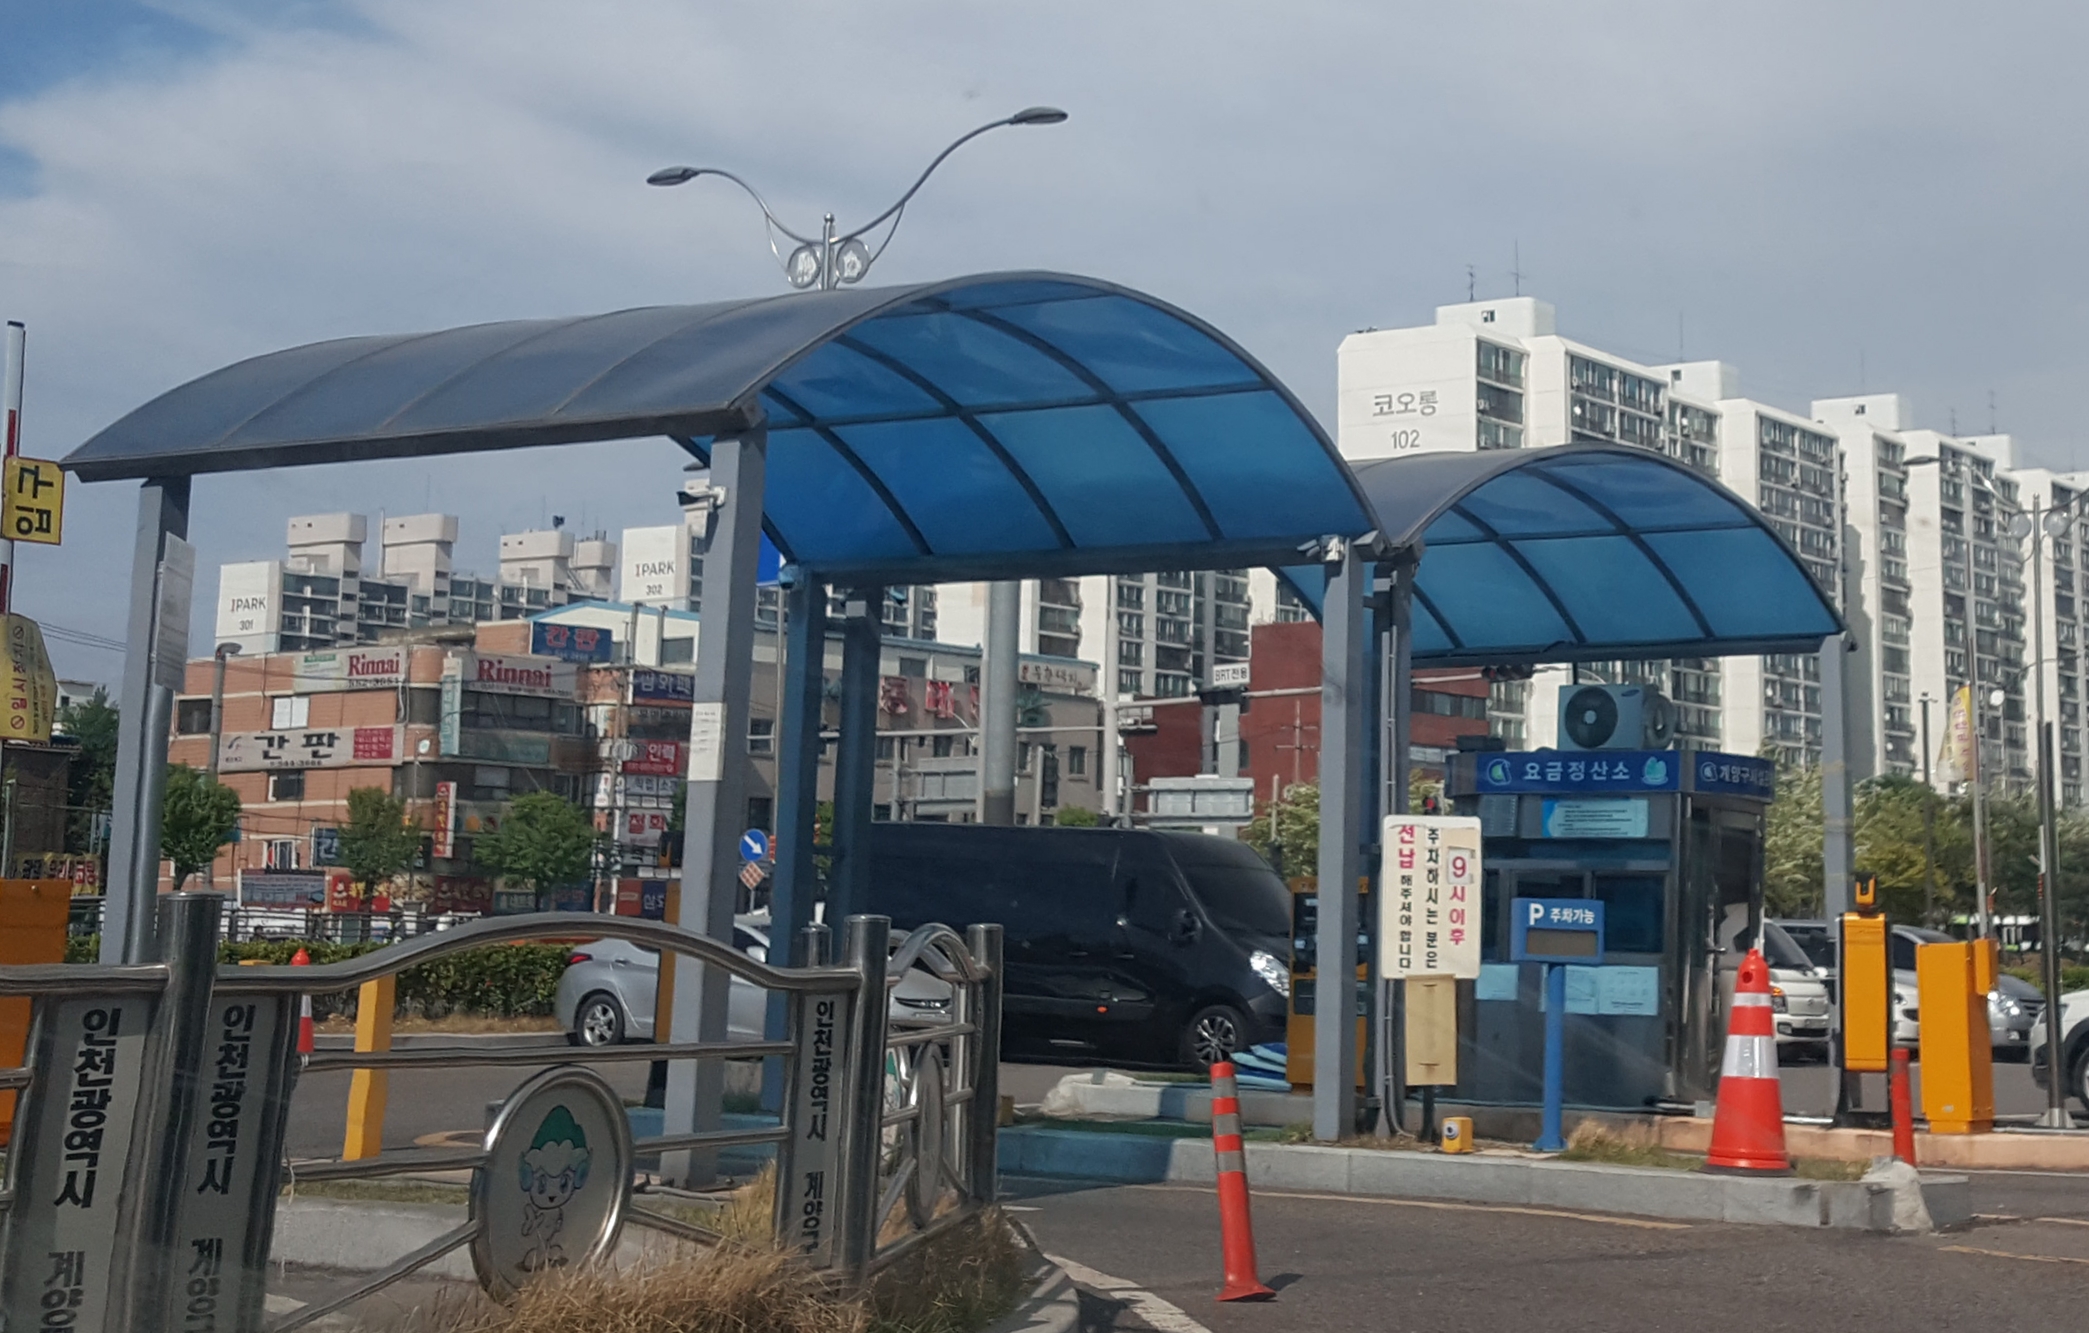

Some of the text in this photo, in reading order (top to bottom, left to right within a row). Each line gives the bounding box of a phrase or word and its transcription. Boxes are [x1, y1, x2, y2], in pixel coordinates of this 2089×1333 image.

[1373, 390, 1438, 417] 코오롱
[1391, 429, 1421, 449] 102
[646, 584, 663, 595] 302
[239, 619, 254, 631] 301
[347, 652, 400, 677] Rinnai
[478, 659, 552, 688] Rinnai
[254, 732, 341, 760] 간판
[1523, 761, 1631, 782] 요금정산소
[1426, 828, 1439, 969] 주차하시는 분은
[1449, 908, 1466, 946] 이후
[1528, 903, 1595, 926] P 주차가능
[806, 1001, 835, 1141] 인천광역시
[198, 1004, 256, 1195] 인천광역시
[39, 1008, 122, 1333] 인천광역시 계양
